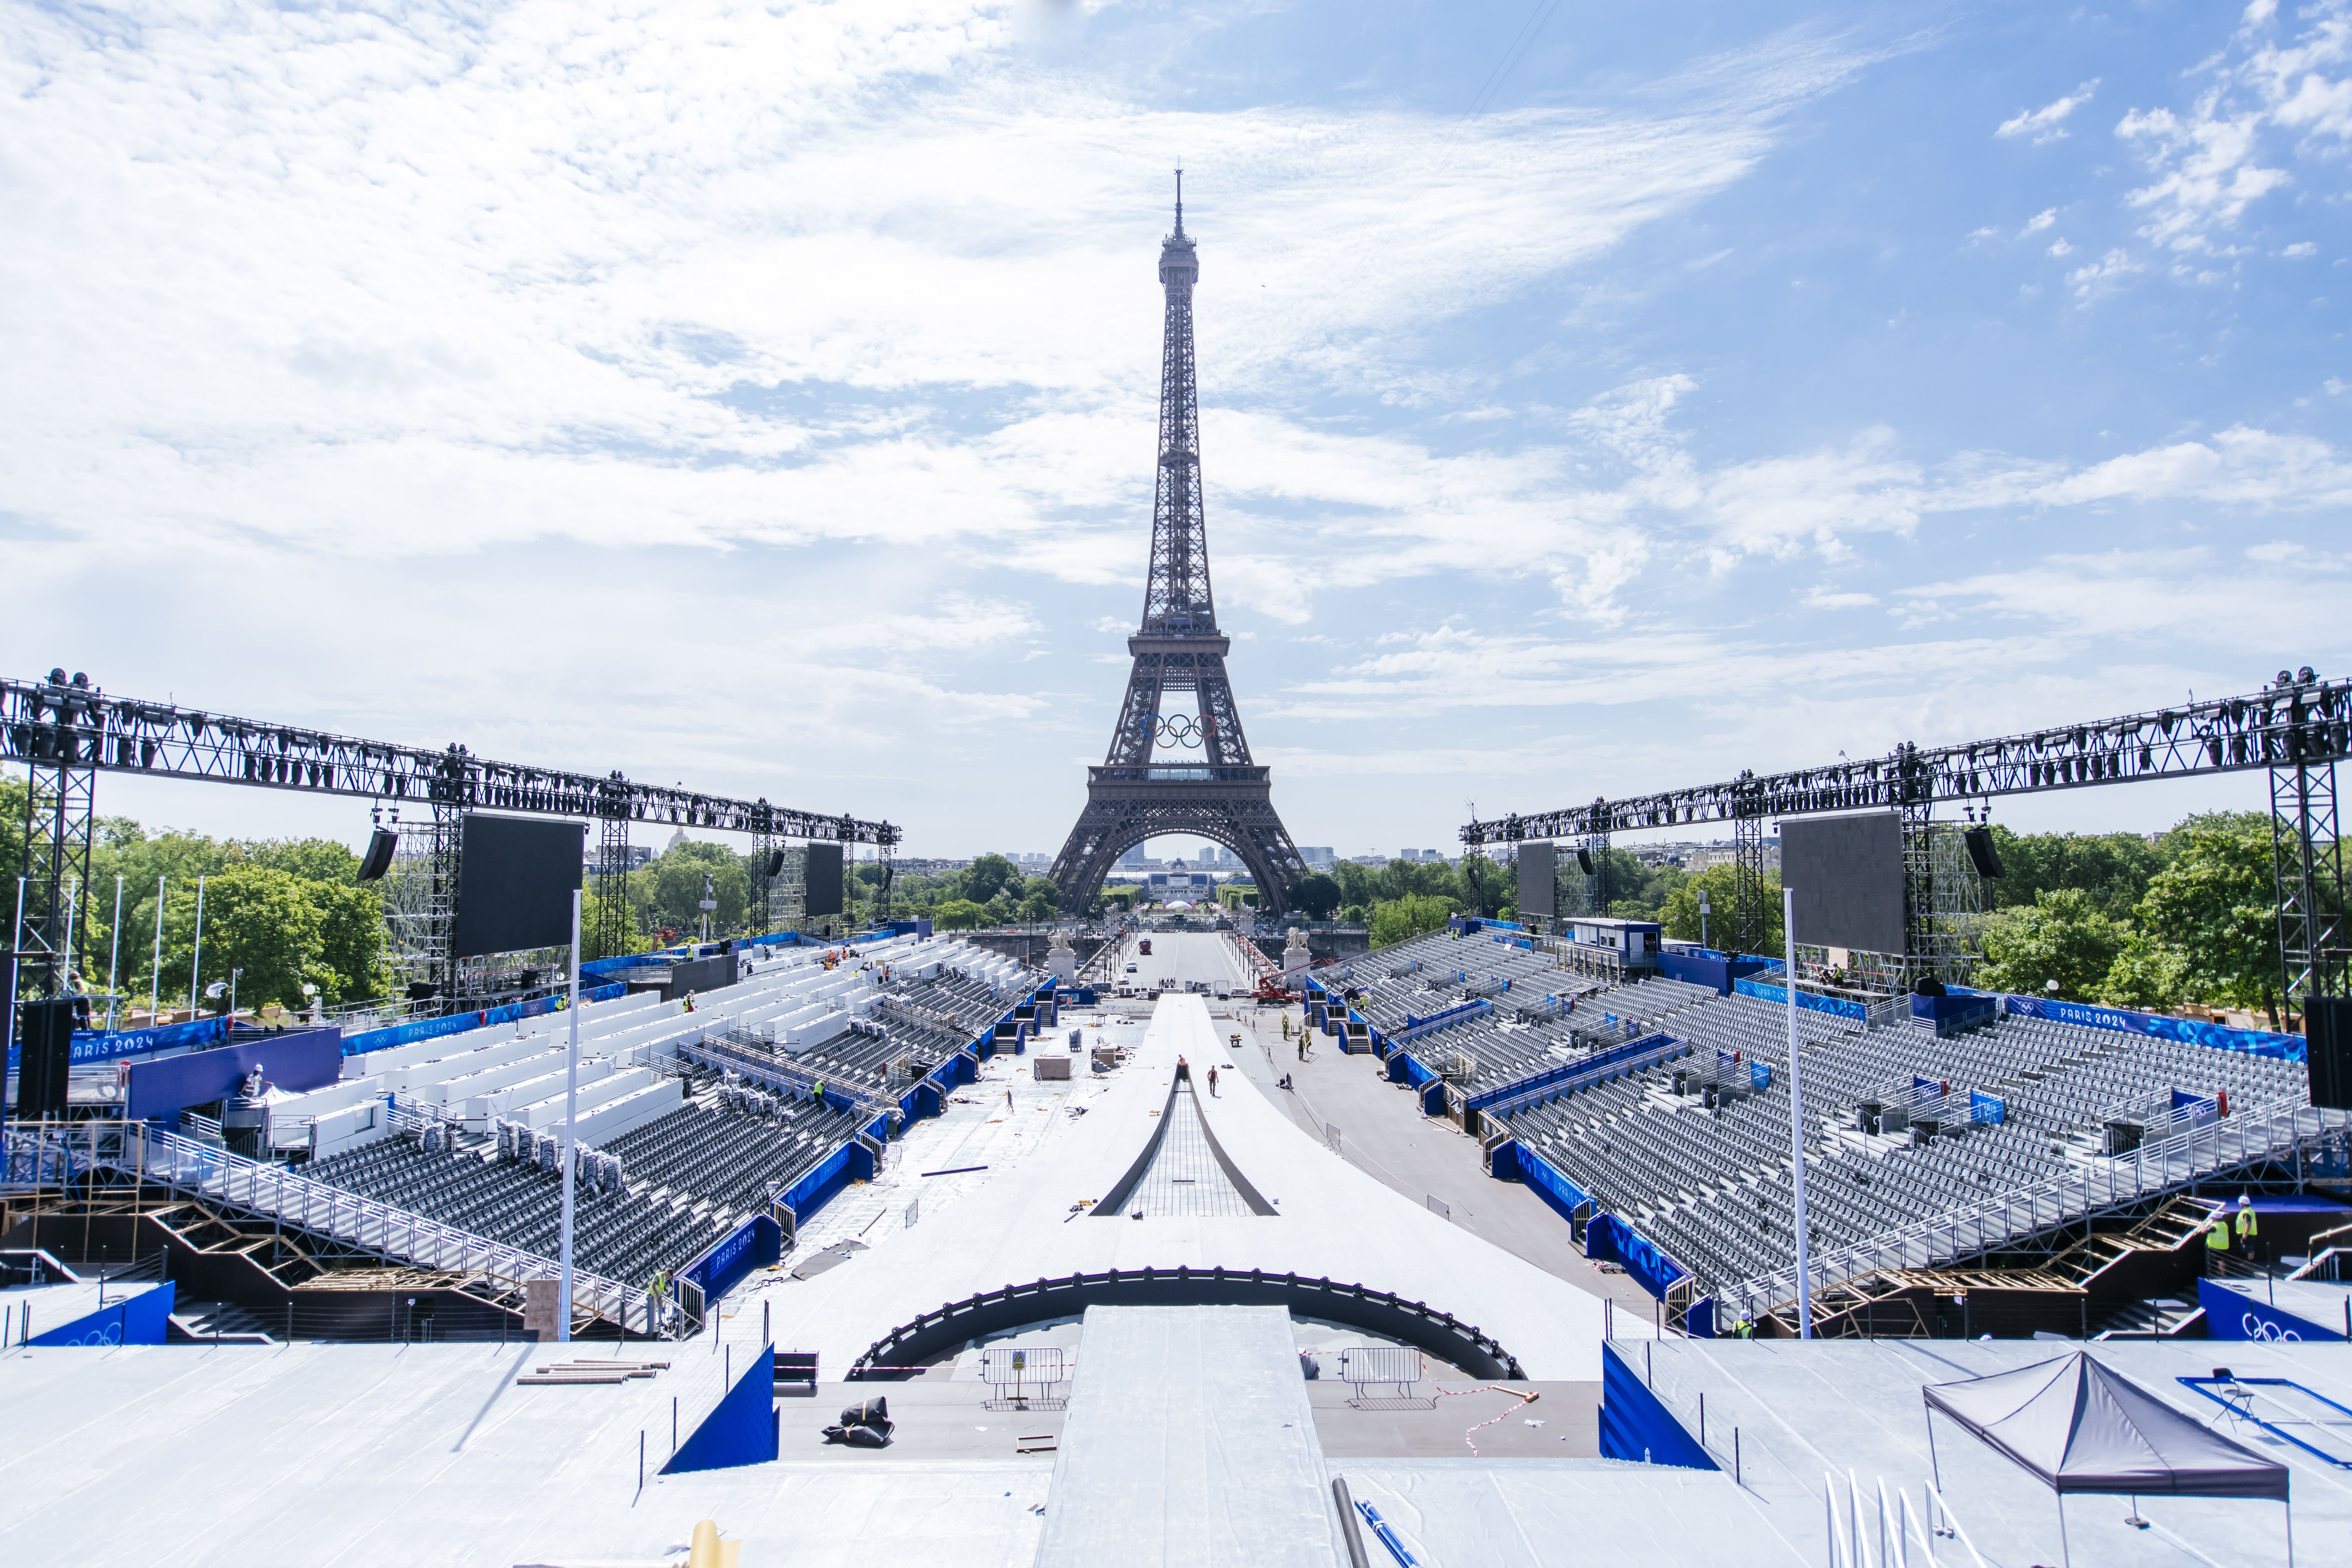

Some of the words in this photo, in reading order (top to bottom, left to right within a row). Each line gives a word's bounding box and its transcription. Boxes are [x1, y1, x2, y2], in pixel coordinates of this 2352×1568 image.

[436, 1021, 456, 1033] 2024
[2095, 1013, 2125, 1027] 2024
[73, 1042, 109, 1058] ARiS
[115, 1035, 153, 1052] 2024
[837, 1150, 848, 1165] 2024
[739, 1229, 755, 1250] 2024
